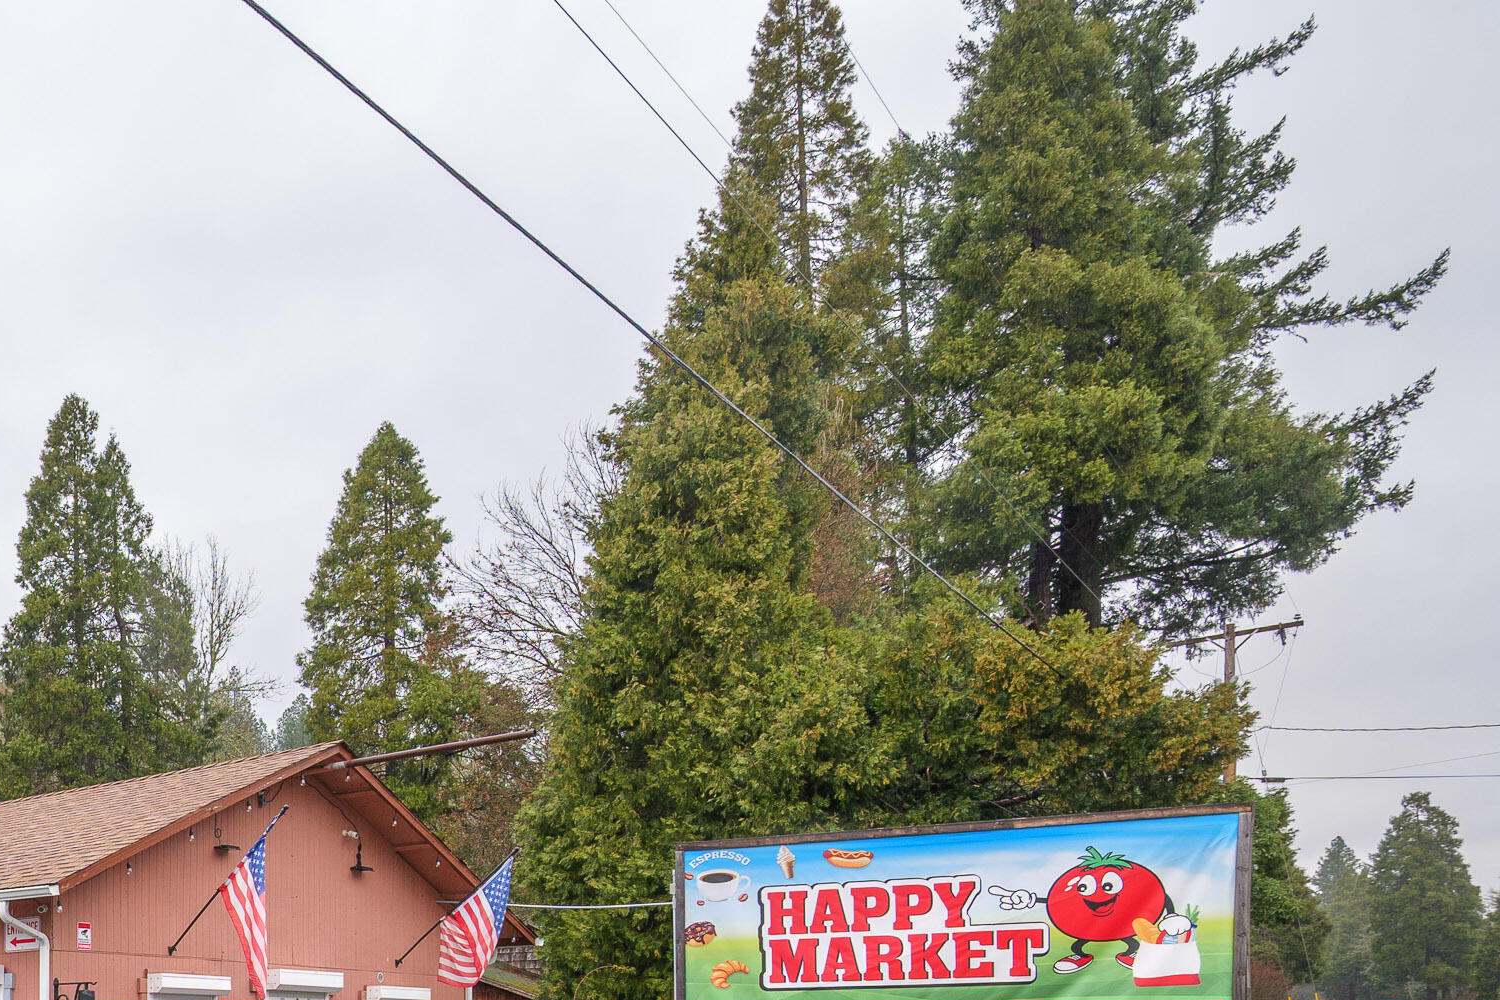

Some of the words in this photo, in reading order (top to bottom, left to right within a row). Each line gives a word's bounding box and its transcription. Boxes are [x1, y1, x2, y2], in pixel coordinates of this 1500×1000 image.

[689, 850, 751, 869] ESPRESSO
[767, 880, 976, 936] HAPPY
[768, 928, 1045, 984] MARKET
